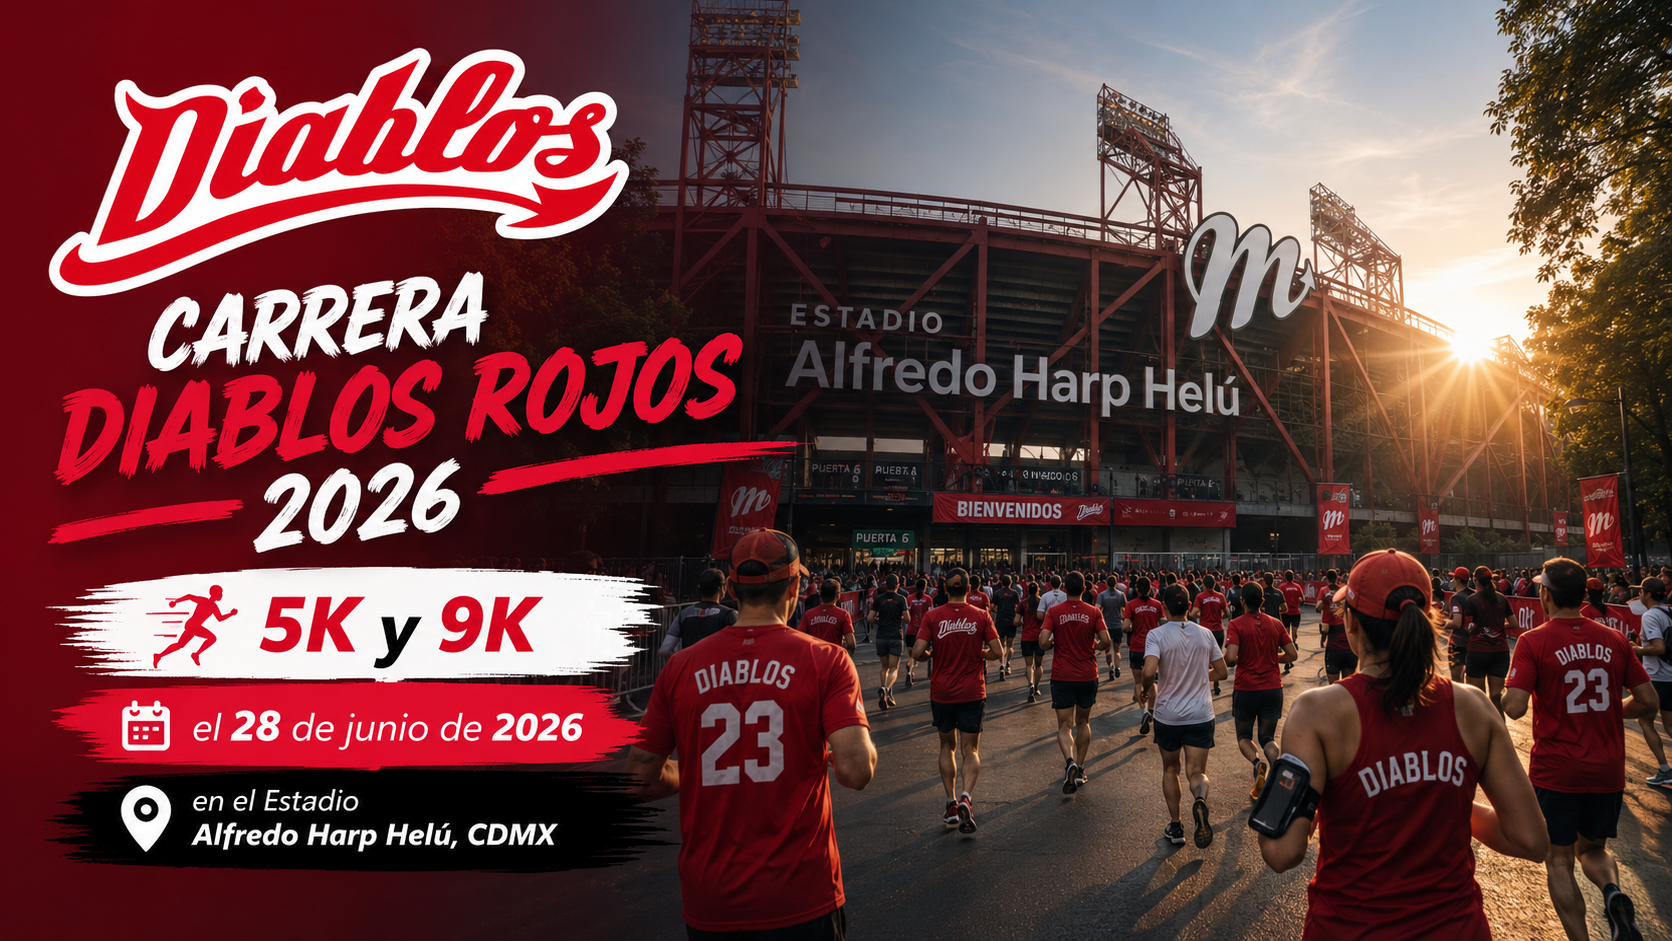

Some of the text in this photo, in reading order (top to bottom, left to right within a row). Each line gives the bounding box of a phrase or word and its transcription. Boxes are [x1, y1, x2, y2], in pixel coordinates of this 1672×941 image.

[790, 303, 943, 334] ESTADIO
[785, 339, 1240, 418] Alfredo Harp Helú
[957, 501, 1062, 519] BIENVENIDOS
[856, 532, 909, 543] PUERTA 6
[1554, 643, 1613, 666] DIABLOS
[694, 659, 796, 695] DIABLOS
[1564, 668, 1610, 714] 23
[701, 699, 784, 787] 23
[1358, 750, 1467, 798] DIABLOS
